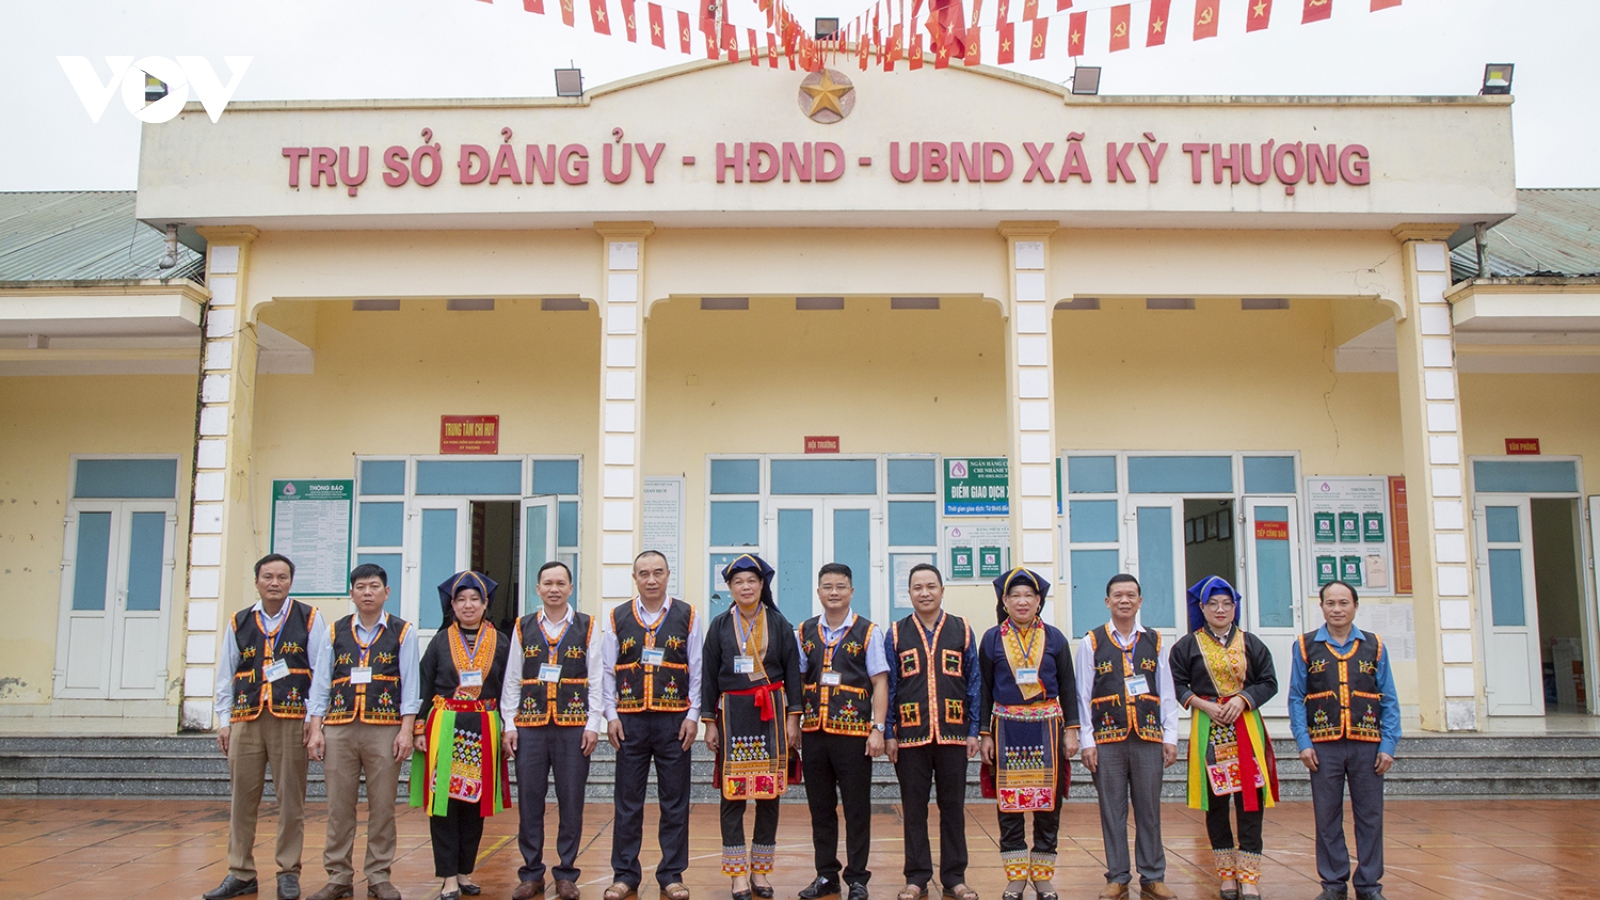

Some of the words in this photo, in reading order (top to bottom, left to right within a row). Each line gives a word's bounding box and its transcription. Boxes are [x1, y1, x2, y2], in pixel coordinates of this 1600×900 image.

[282, 145, 369, 197] TRỤ
[382, 127, 443, 187] SỞ
[457, 126, 590, 186] ĐẢNG
[602, 126, 667, 184] ỦY
[716, 141, 845, 183] HĐND
[890, 141, 1014, 183] UBND
[1022, 131, 1092, 183] XÃ
[1107, 131, 1169, 183] KỲ
[1182, 138, 1371, 196] THƯỢNG
[445, 422, 462, 436] TRUNG
[463, 420, 474, 436] TÂM
[475, 417, 484, 436] CHỈ
[484, 422, 495, 436] HUY
[951, 481, 970, 499] ĐIỂM
[971, 485, 988, 499] GIAO
[989, 485, 1005, 501] DỊCH
